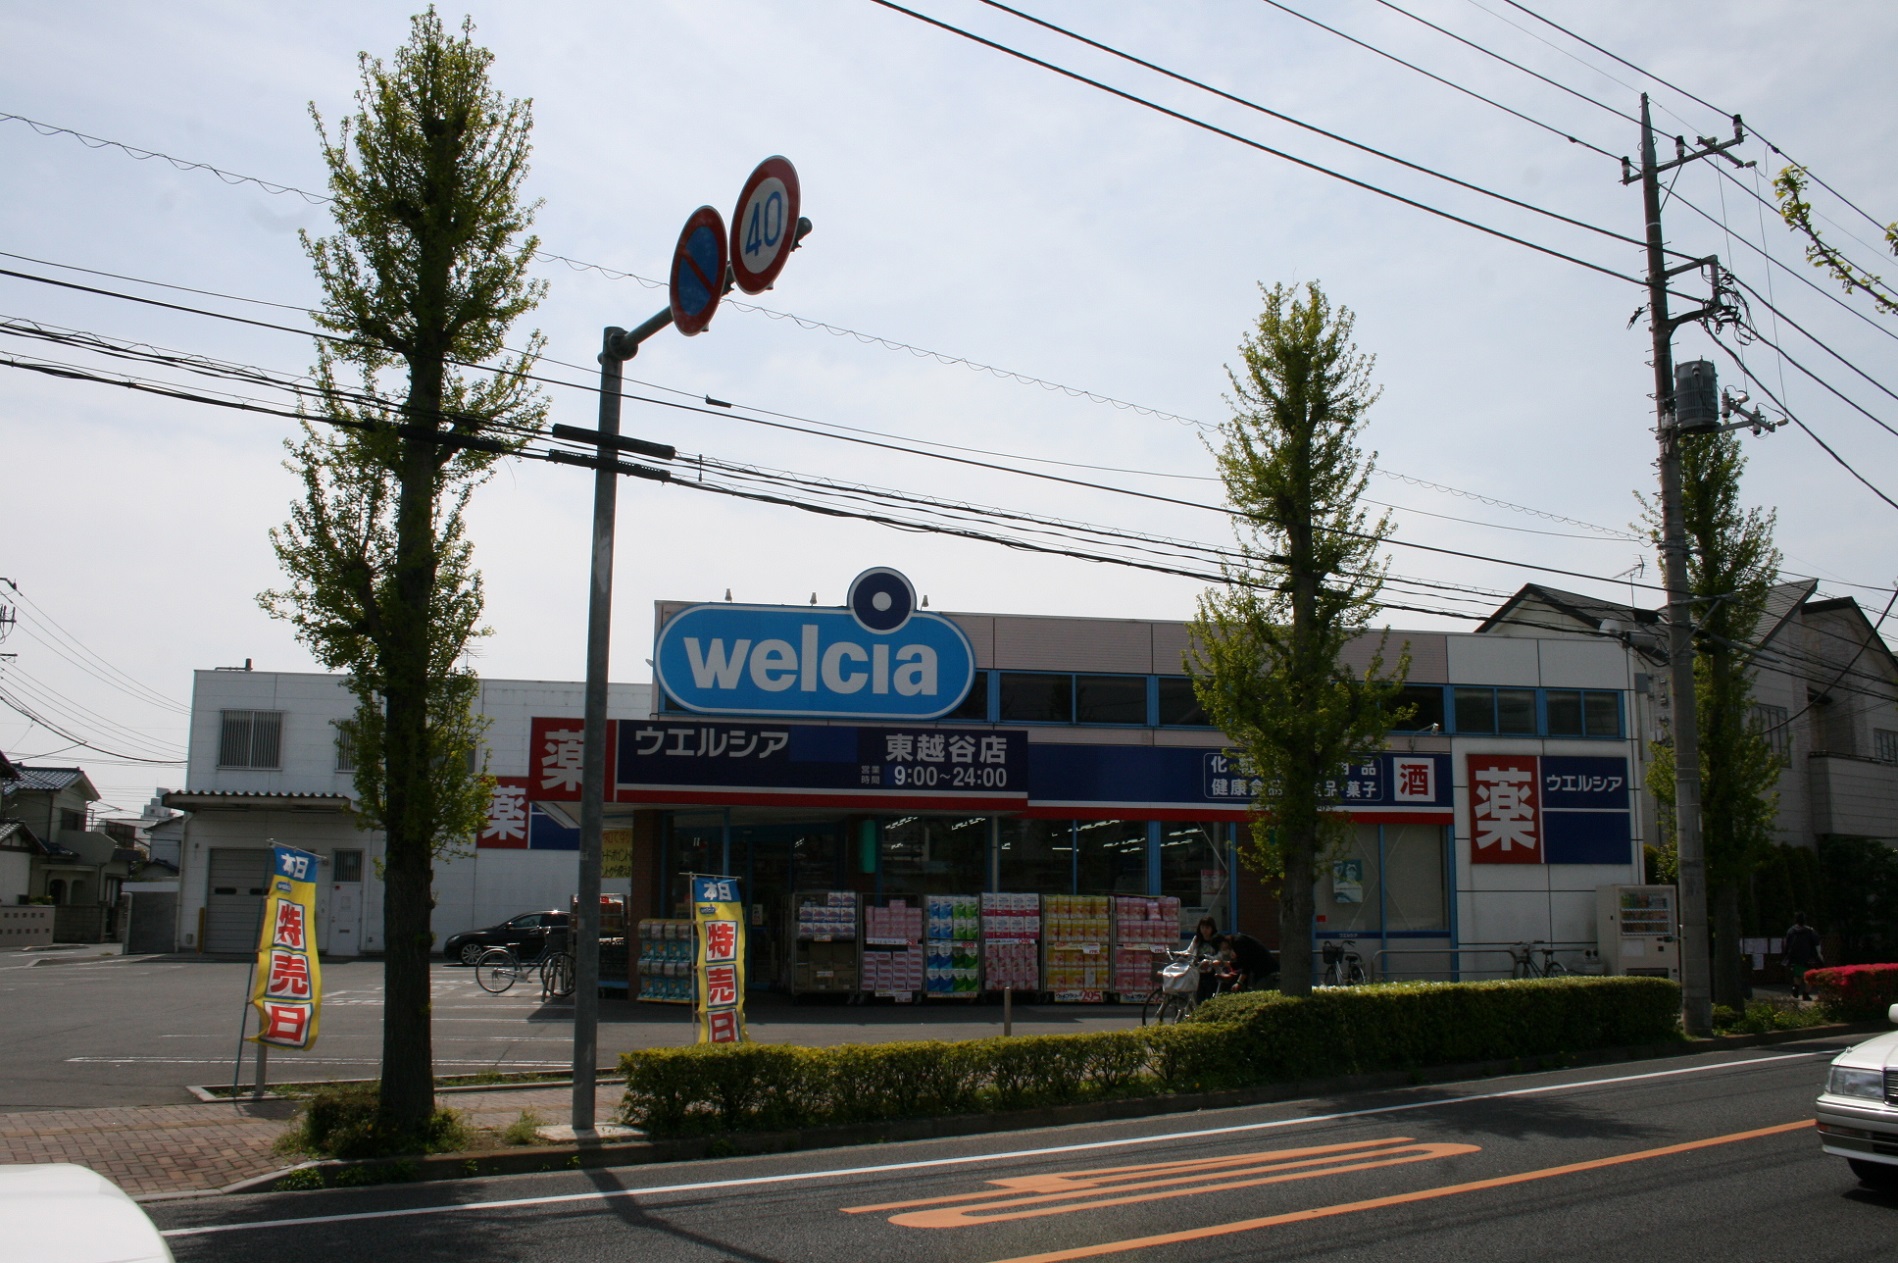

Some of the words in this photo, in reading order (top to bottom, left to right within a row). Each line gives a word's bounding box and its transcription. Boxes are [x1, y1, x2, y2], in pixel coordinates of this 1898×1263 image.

[745, 191, 782, 257] 40
[683, 624, 938, 696] welcia
[540, 729, 584, 791] 薬
[635, 726, 789, 759] ウエルシア
[885, 734, 1007, 765] 東越谷店
[1399, 763, 1429, 797] 酒
[1475, 766, 1537, 851] 薬
[1545, 774, 1624, 793] ウエルシア
[481, 784, 526, 841] 薬
[281, 853, 309, 880] 本日
[703, 881, 732, 901] 本日
[267, 903, 309, 1043] 特売日
[707, 923, 737, 1043] 特売日
